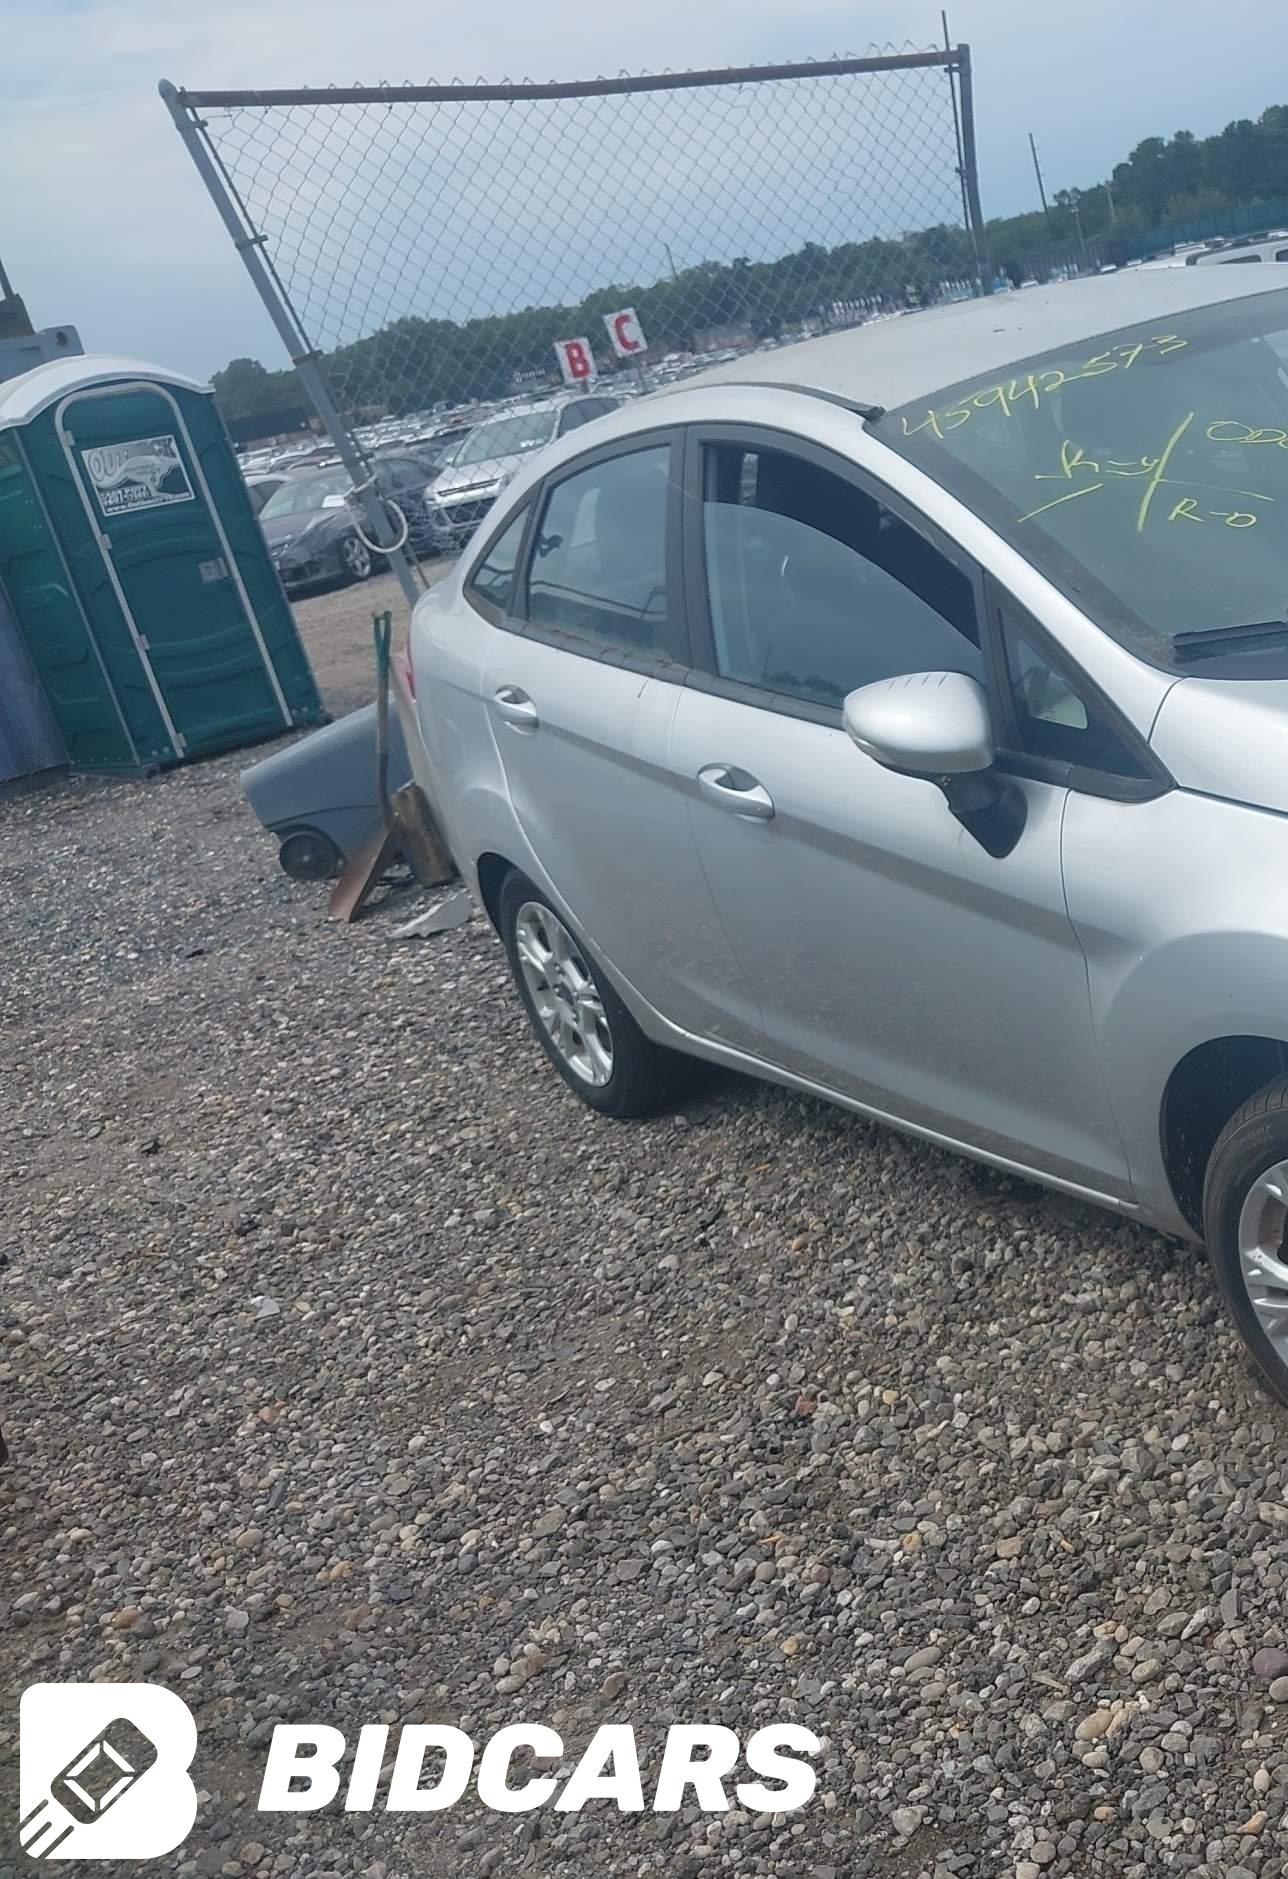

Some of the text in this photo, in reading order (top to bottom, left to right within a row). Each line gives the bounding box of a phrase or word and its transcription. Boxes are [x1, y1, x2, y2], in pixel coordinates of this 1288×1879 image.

[614, 314, 641, 351] C
[565, 342, 591, 378] B
[901, 334, 1189, 441] 45942573
